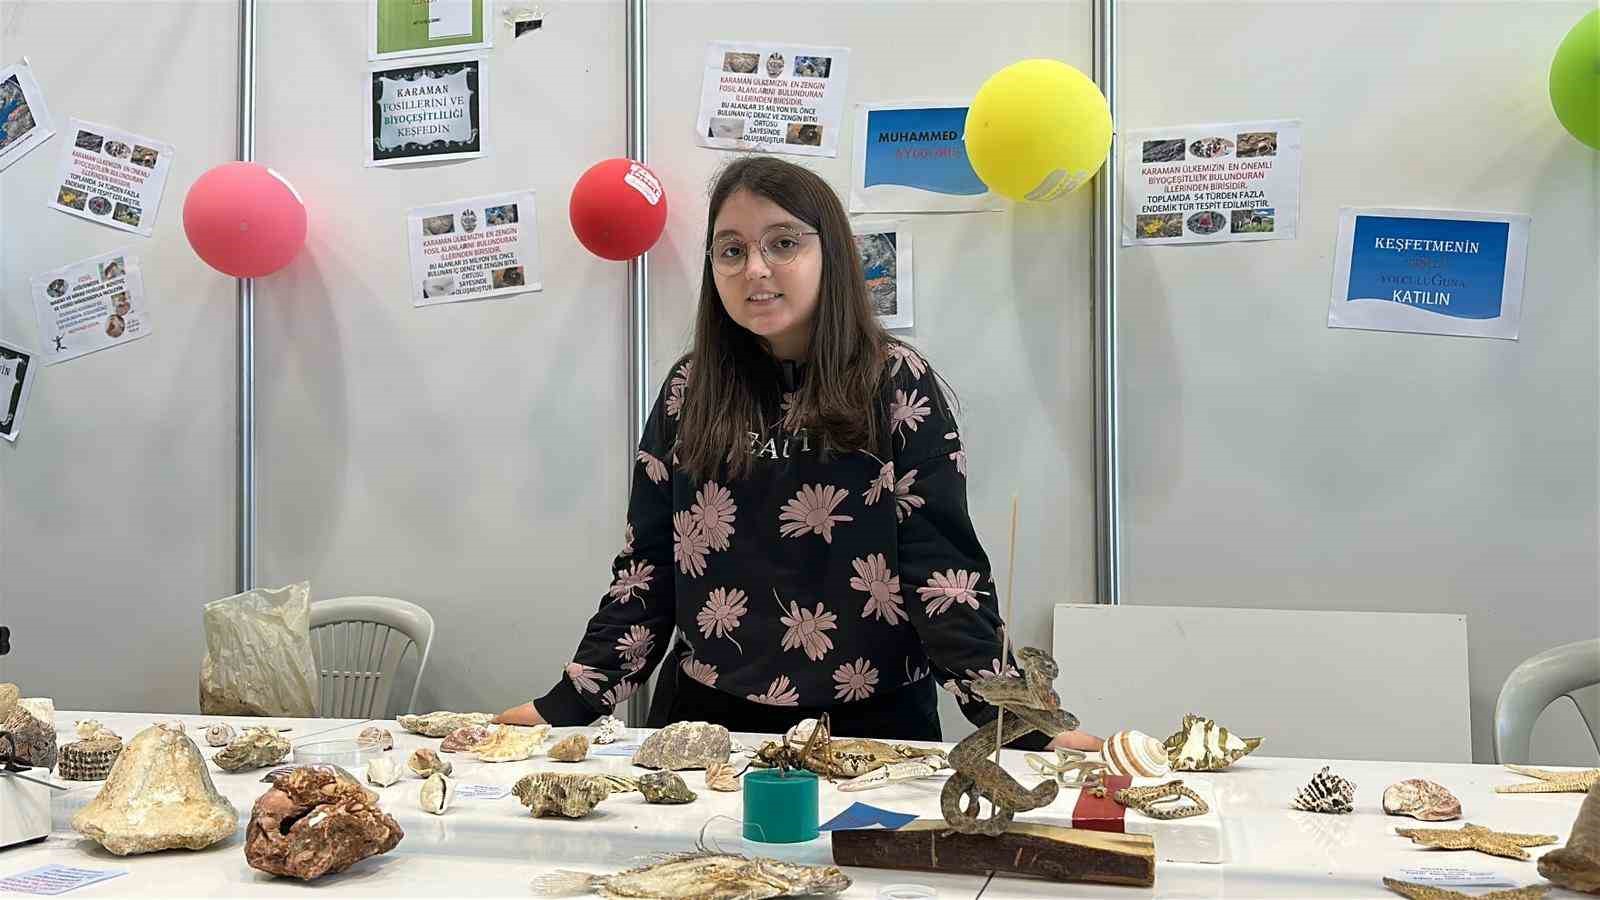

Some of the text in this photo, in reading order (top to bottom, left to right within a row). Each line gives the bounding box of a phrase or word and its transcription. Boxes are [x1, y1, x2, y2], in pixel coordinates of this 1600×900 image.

[397, 84, 448, 97] KARAMAN
[450, 96, 464, 105] VE
[879, 131, 958, 143] MUHAMMED
[1142, 166, 1181, 176] KARAMAN
[1228, 162, 1239, 171] EN
[1209, 171, 1265, 181] BULUNDURAN
[1147, 193, 1191, 204] TOPLAMDA
[1194, 192, 1204, 200] 54
[1239, 190, 1265, 199] FAZLA
[1392, 289, 1451, 306] KATILIN
